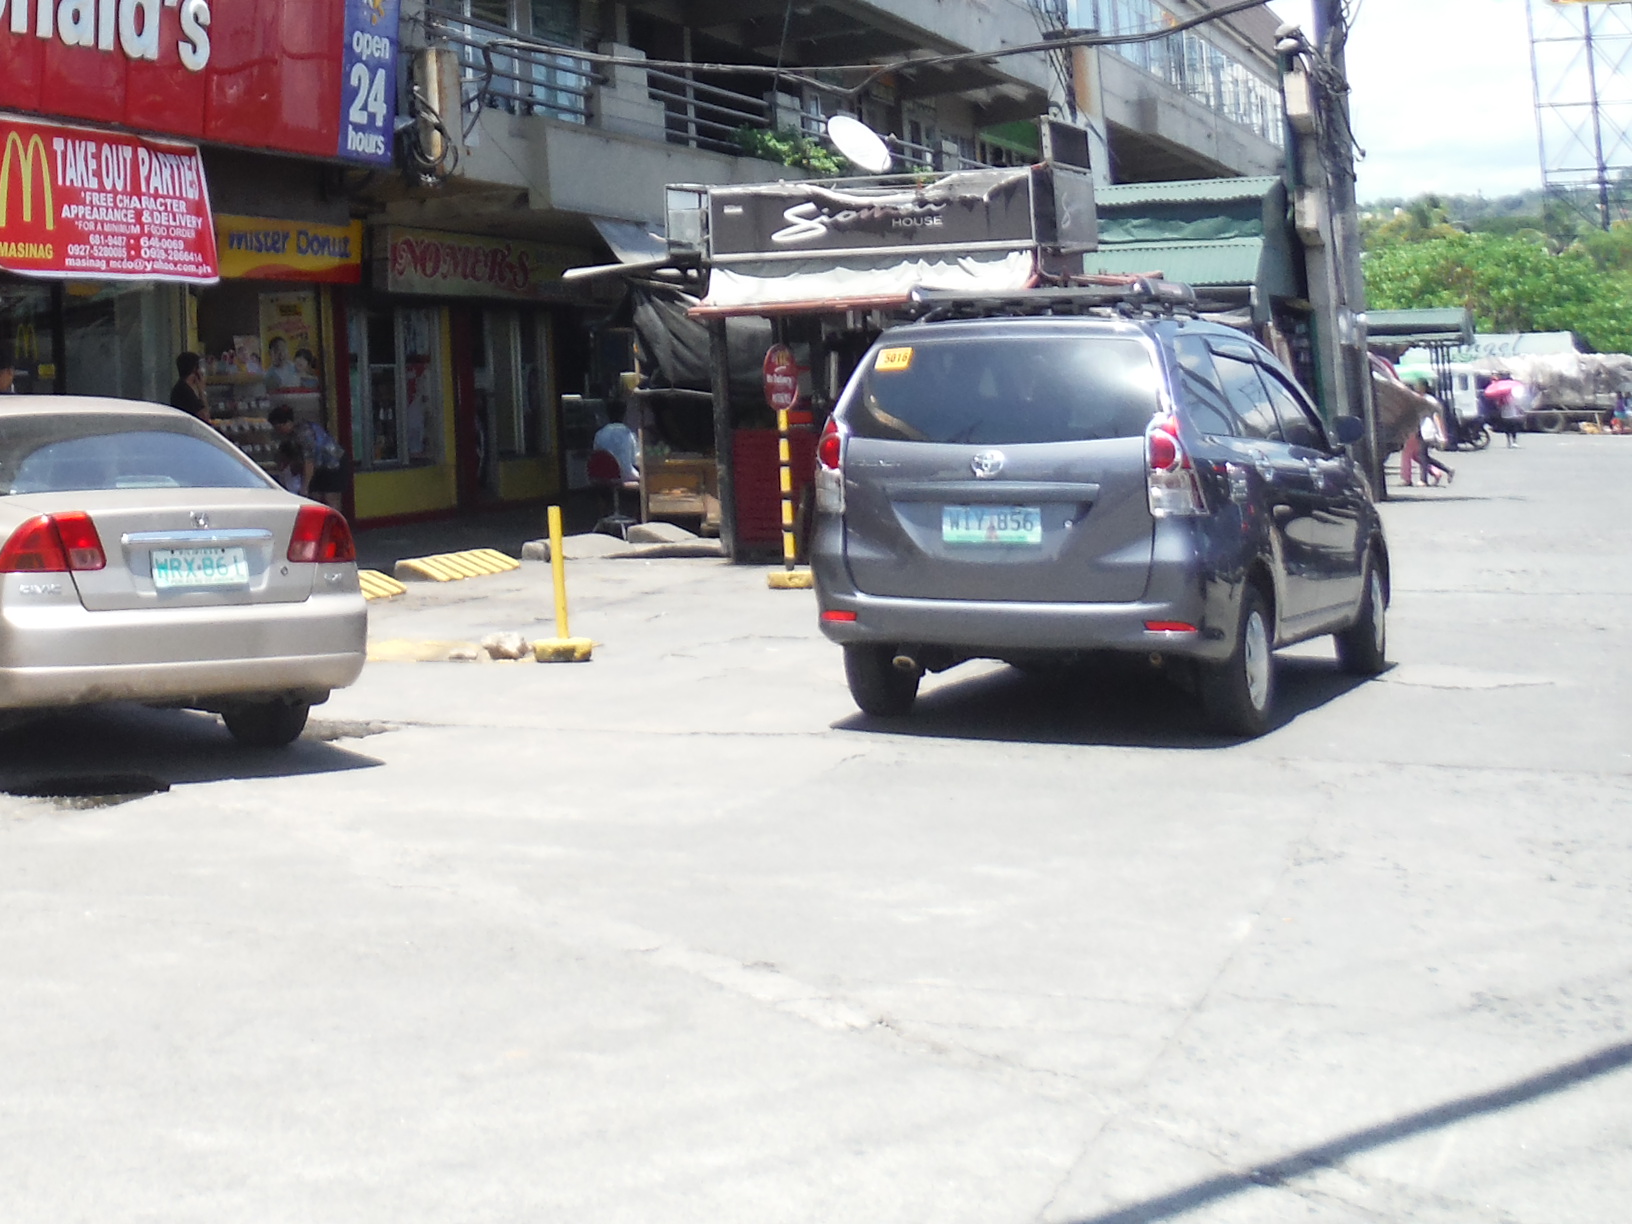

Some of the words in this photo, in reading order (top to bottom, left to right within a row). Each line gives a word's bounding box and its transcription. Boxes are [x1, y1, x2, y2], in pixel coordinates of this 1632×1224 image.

[352, 30, 390, 60] open
[349, 63, 386, 127] 24
[347, 124, 385, 155] hours
[52, 136, 99, 190] TAKE
[101, 145, 133, 191] OUT
[137, 146, 202, 201] PARTIES
[60, 203, 136, 223] APPEARANCE
[116, 193, 187, 213] CHARACTER
[104, 222, 141, 235] MINIMUM
[144, 224, 168, 236] FOOD
[169, 225, 196, 239] ORDER
[891, 215, 944, 229] HOUSE
[296, 229, 351, 259] Donut
